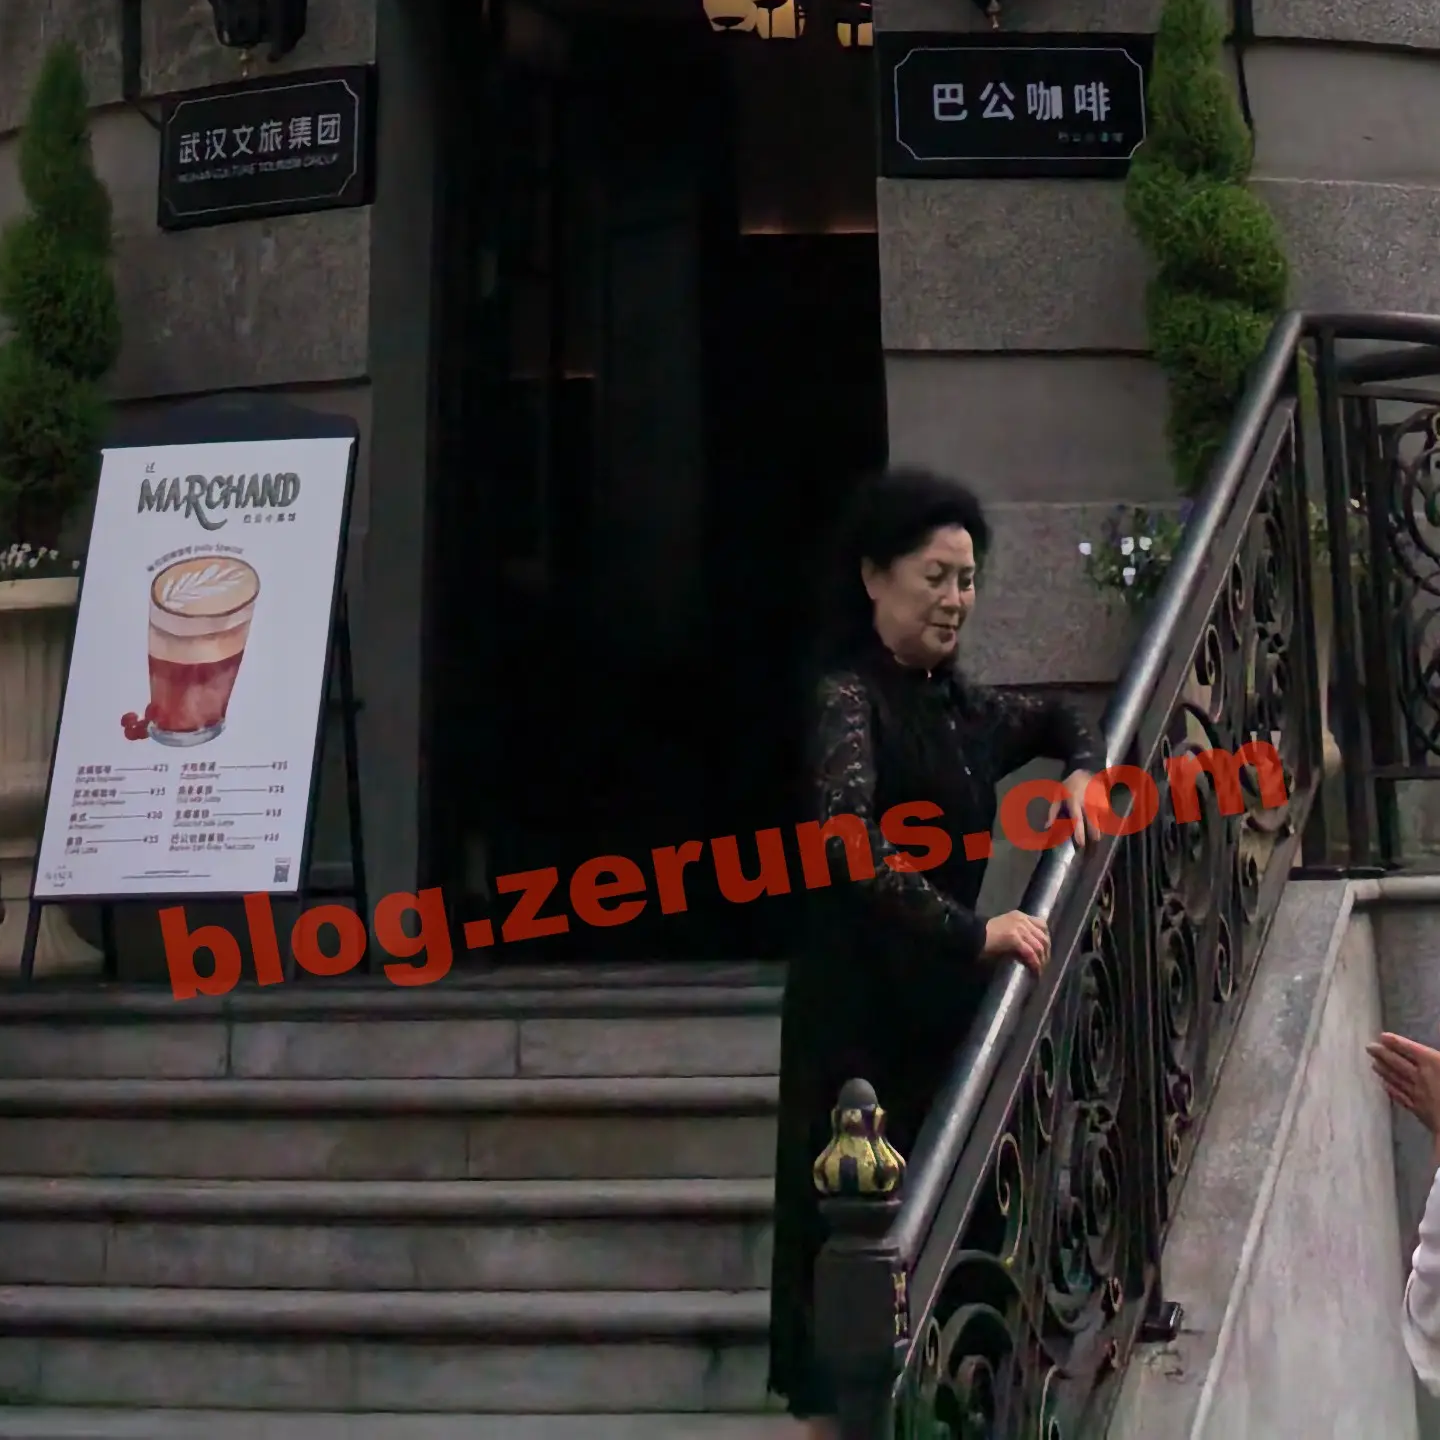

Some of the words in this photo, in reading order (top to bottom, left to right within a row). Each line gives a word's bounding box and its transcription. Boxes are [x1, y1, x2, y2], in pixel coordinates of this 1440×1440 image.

[932, 81, 1111, 122] 巴公咖啡
[178, 113, 341, 164] 武汉文旅集团
[137, 472, 301, 531] MARCHAND
